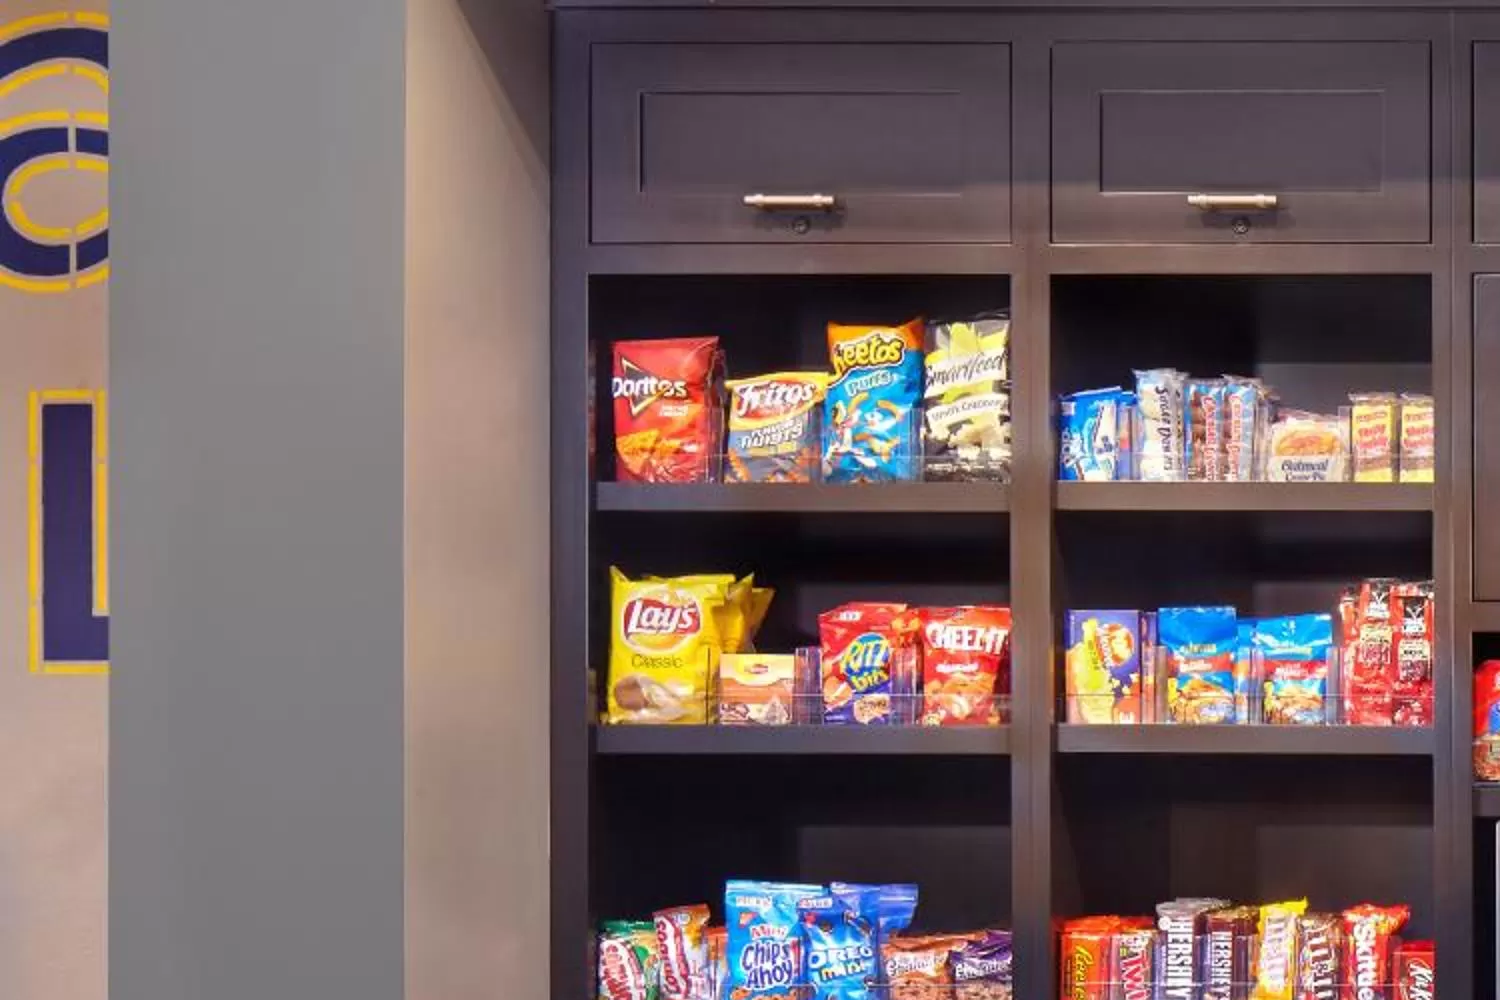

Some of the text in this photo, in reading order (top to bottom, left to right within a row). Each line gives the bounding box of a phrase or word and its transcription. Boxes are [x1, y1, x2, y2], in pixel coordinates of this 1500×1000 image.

[611, 376, 687, 398] Doritos
[736, 381, 817, 417] Fritos
[627, 600, 697, 634] Lay's
[631, 654, 683, 669] Classic
